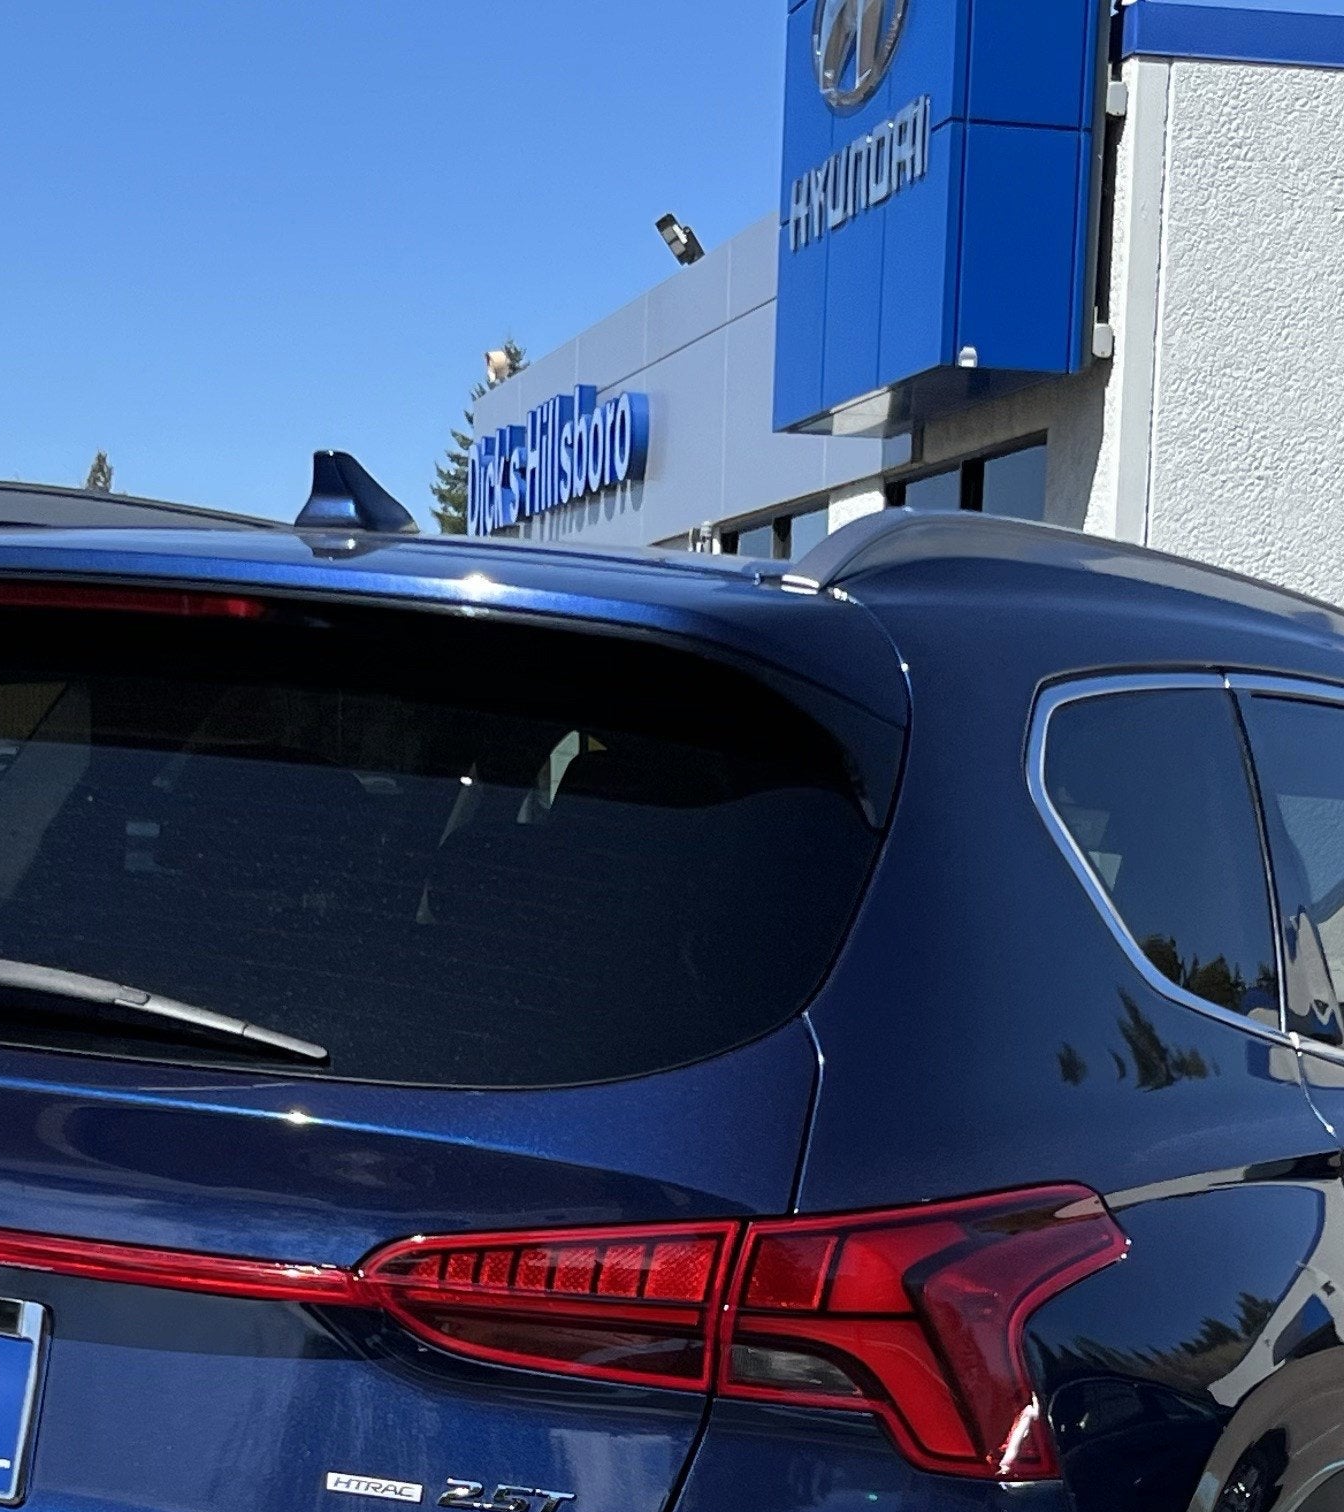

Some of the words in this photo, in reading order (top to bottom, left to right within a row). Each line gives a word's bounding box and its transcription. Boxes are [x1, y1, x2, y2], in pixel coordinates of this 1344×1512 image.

[789, 94, 931, 252] HYUNDAI
[467, 425, 522, 537] Dick's
[525, 384, 636, 517] Hillsboro
[331, 1475, 415, 1499] HTRAC
